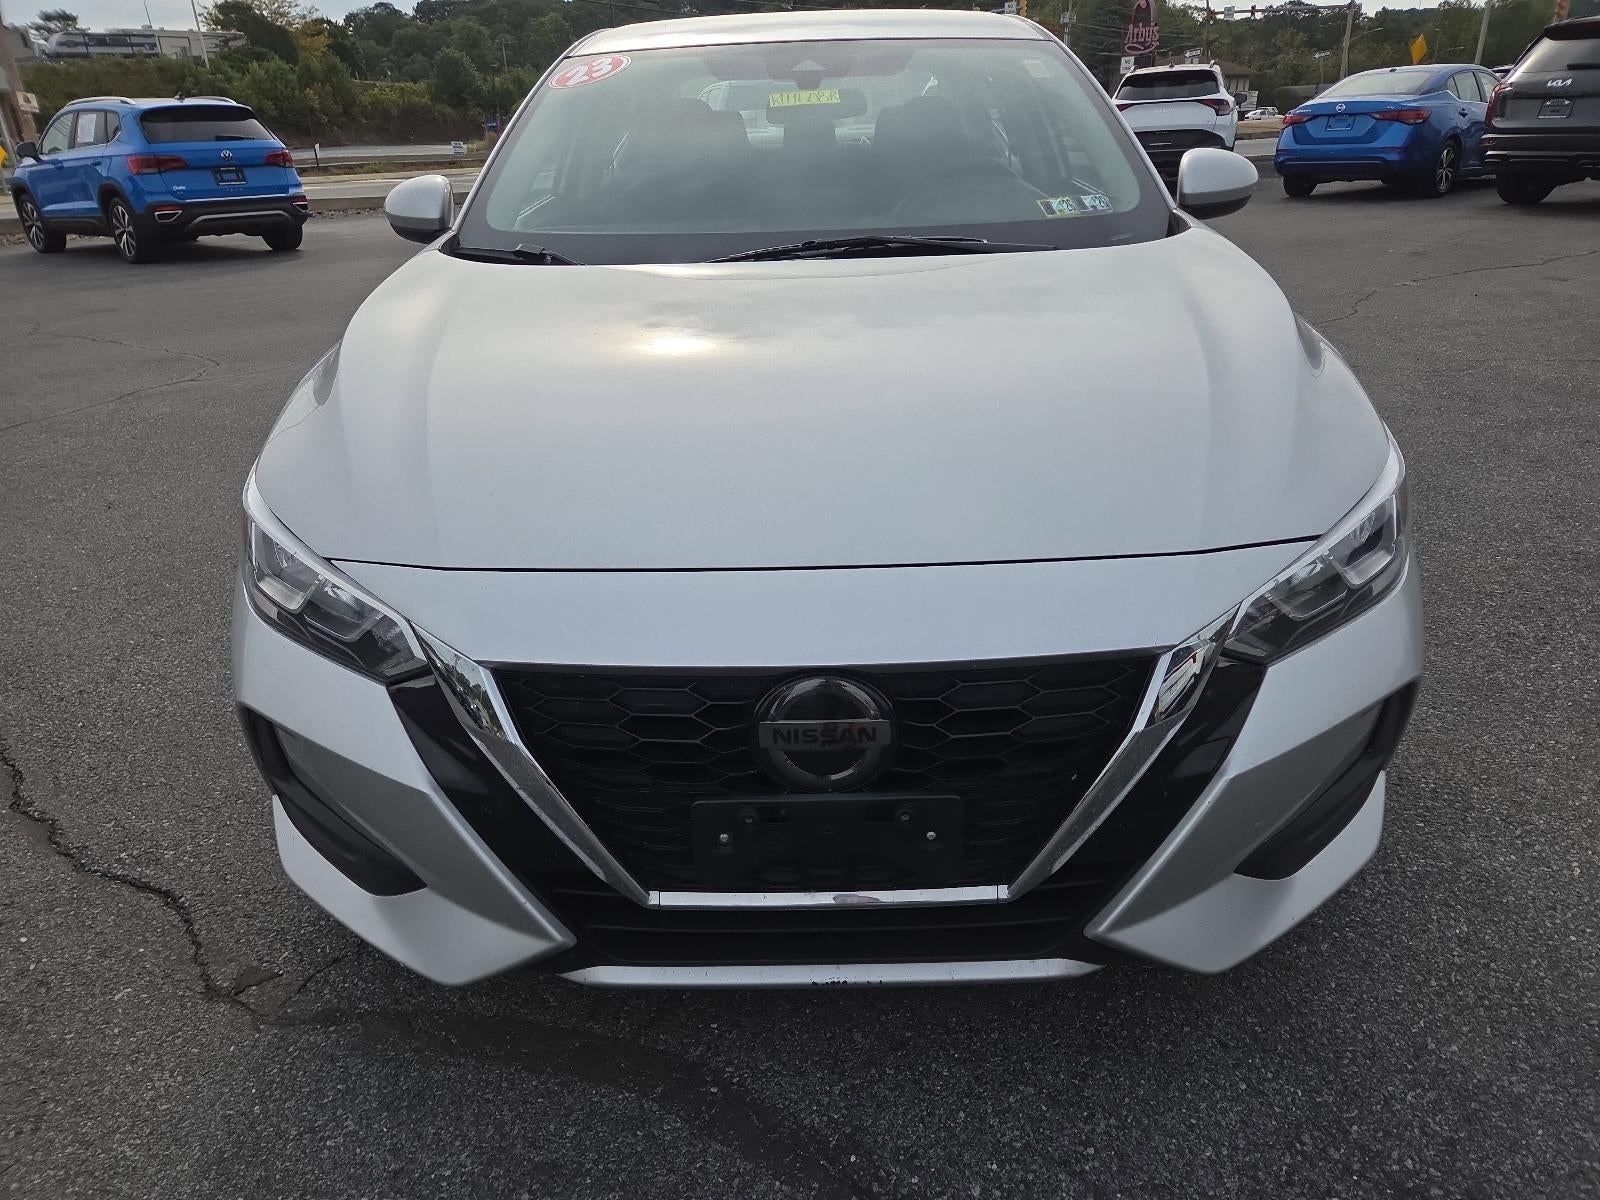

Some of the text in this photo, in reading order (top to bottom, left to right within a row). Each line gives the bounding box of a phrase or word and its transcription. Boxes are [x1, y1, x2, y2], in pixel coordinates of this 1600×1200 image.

[1124, 22, 1159, 47] Arby's
[565, 57, 613, 86] 23
[772, 726, 877, 744] NISSAN
